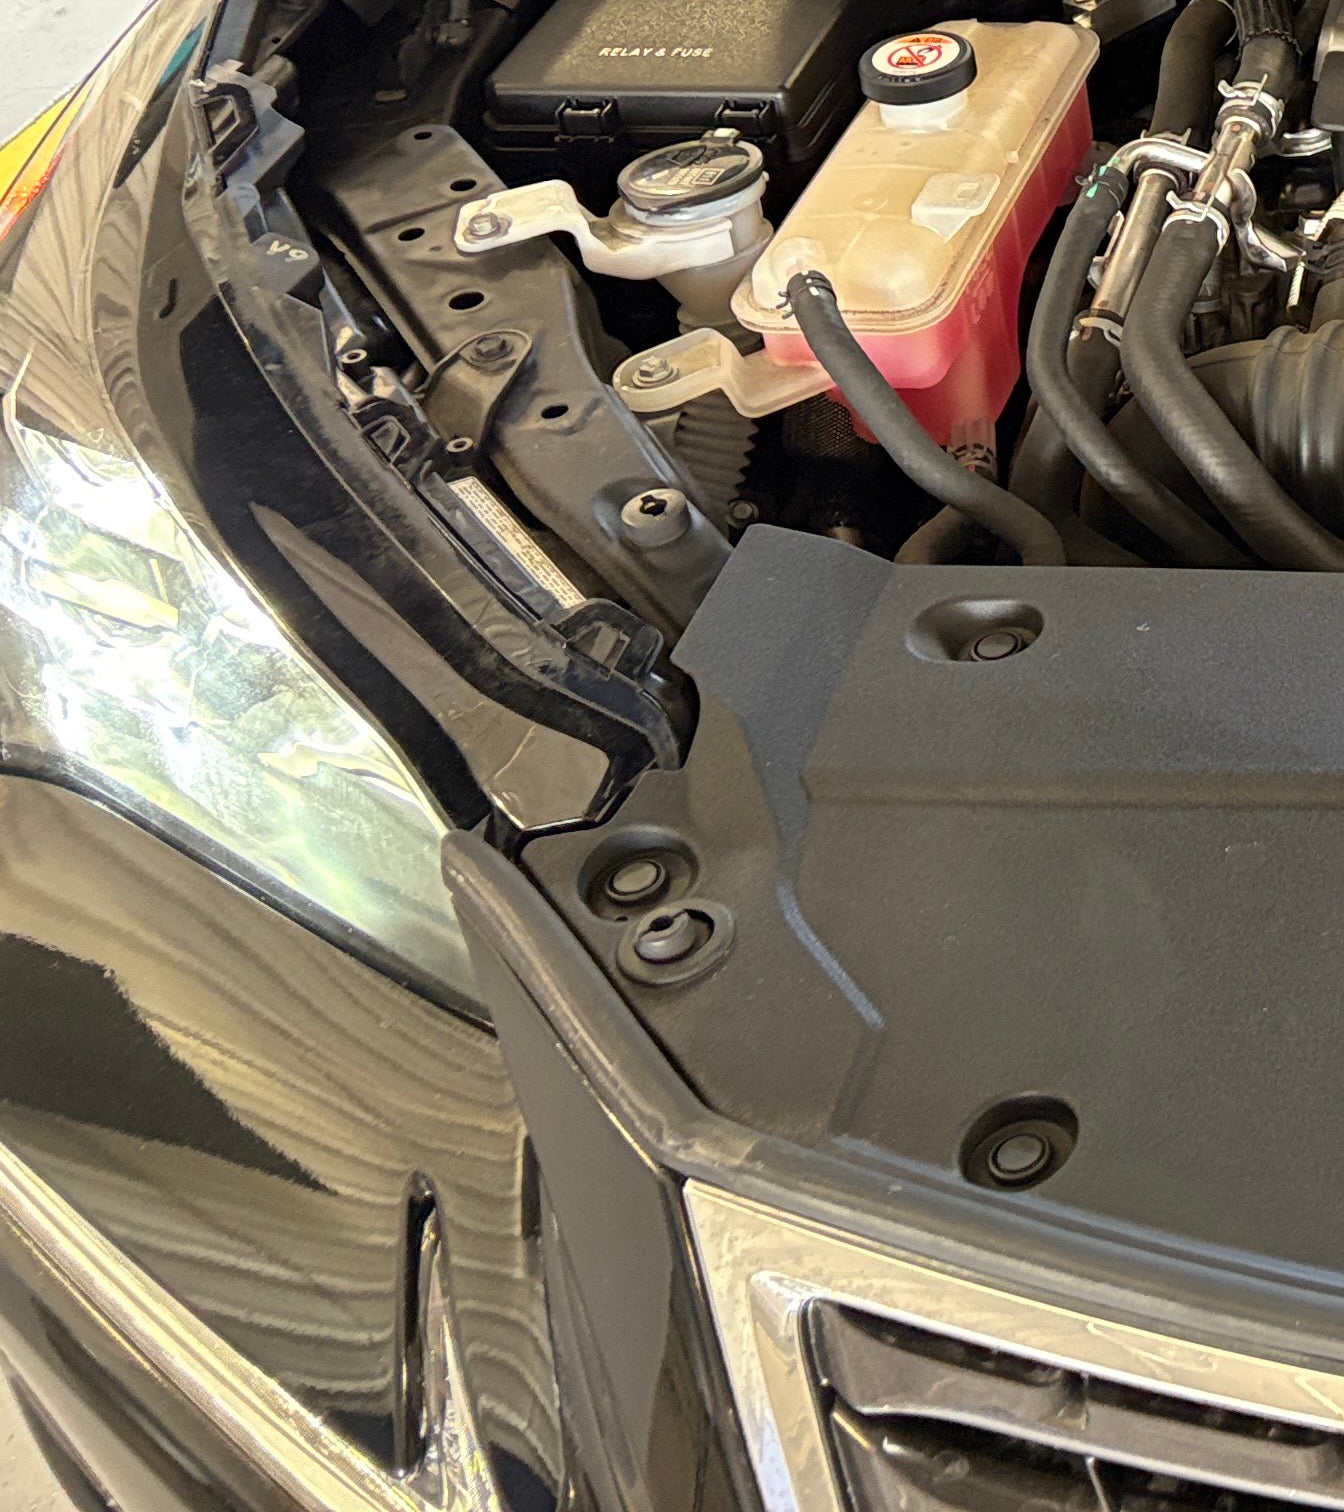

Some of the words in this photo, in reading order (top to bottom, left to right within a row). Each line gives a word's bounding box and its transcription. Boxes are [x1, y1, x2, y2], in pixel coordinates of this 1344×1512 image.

[598, 47, 653, 57] RELAY
[655, 47, 666, 57] &
[671, 47, 713, 57] FUSE
